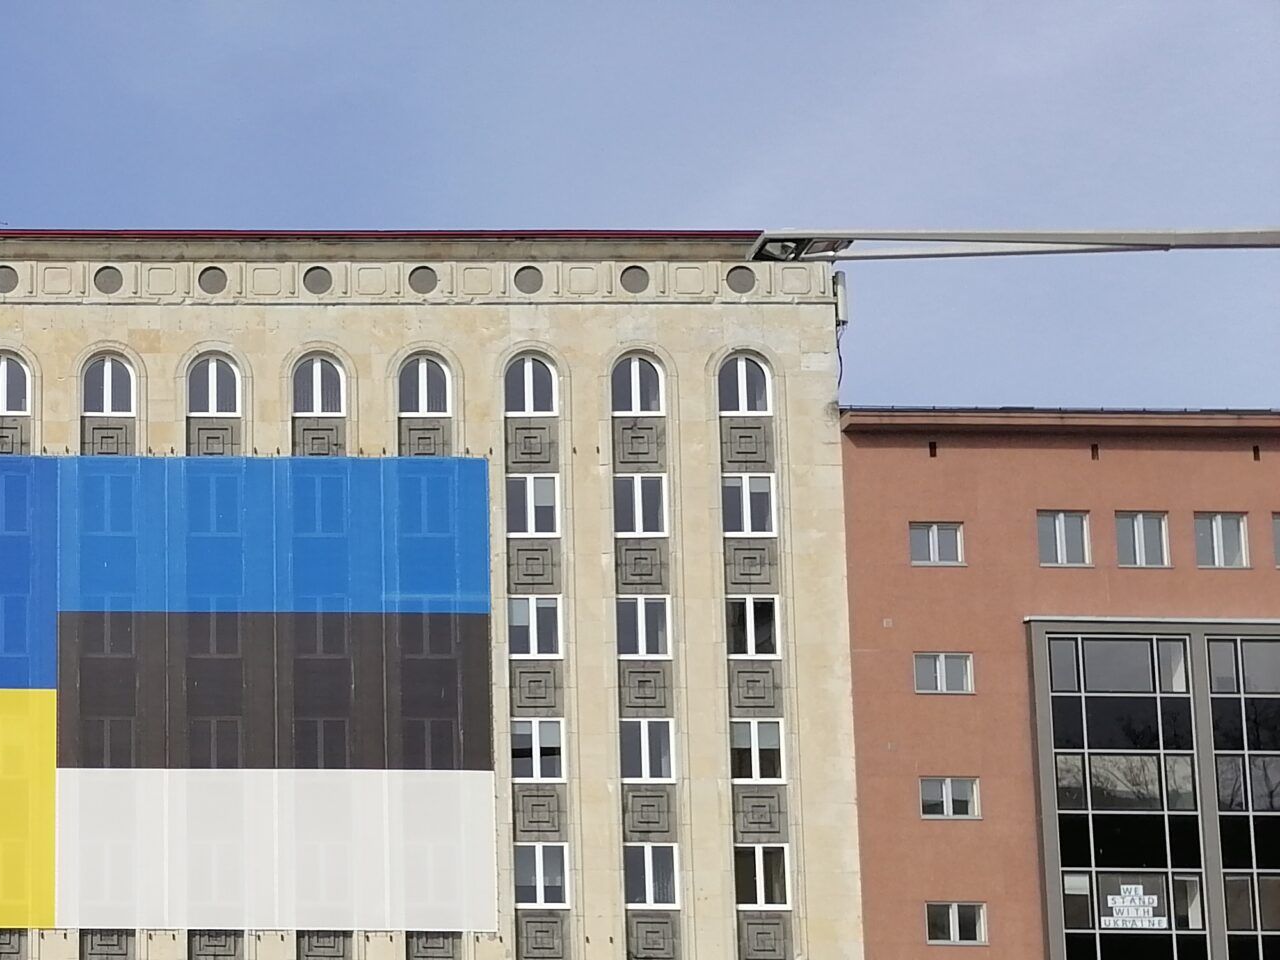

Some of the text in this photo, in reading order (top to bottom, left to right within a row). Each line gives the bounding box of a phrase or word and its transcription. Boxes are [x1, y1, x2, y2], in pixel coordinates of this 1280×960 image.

[1122, 886, 1140, 895] WE
[1111, 896, 1155, 905] STAND
[1114, 907, 1150, 916] WITH
[1104, 918, 1163, 928] UKRAINE
